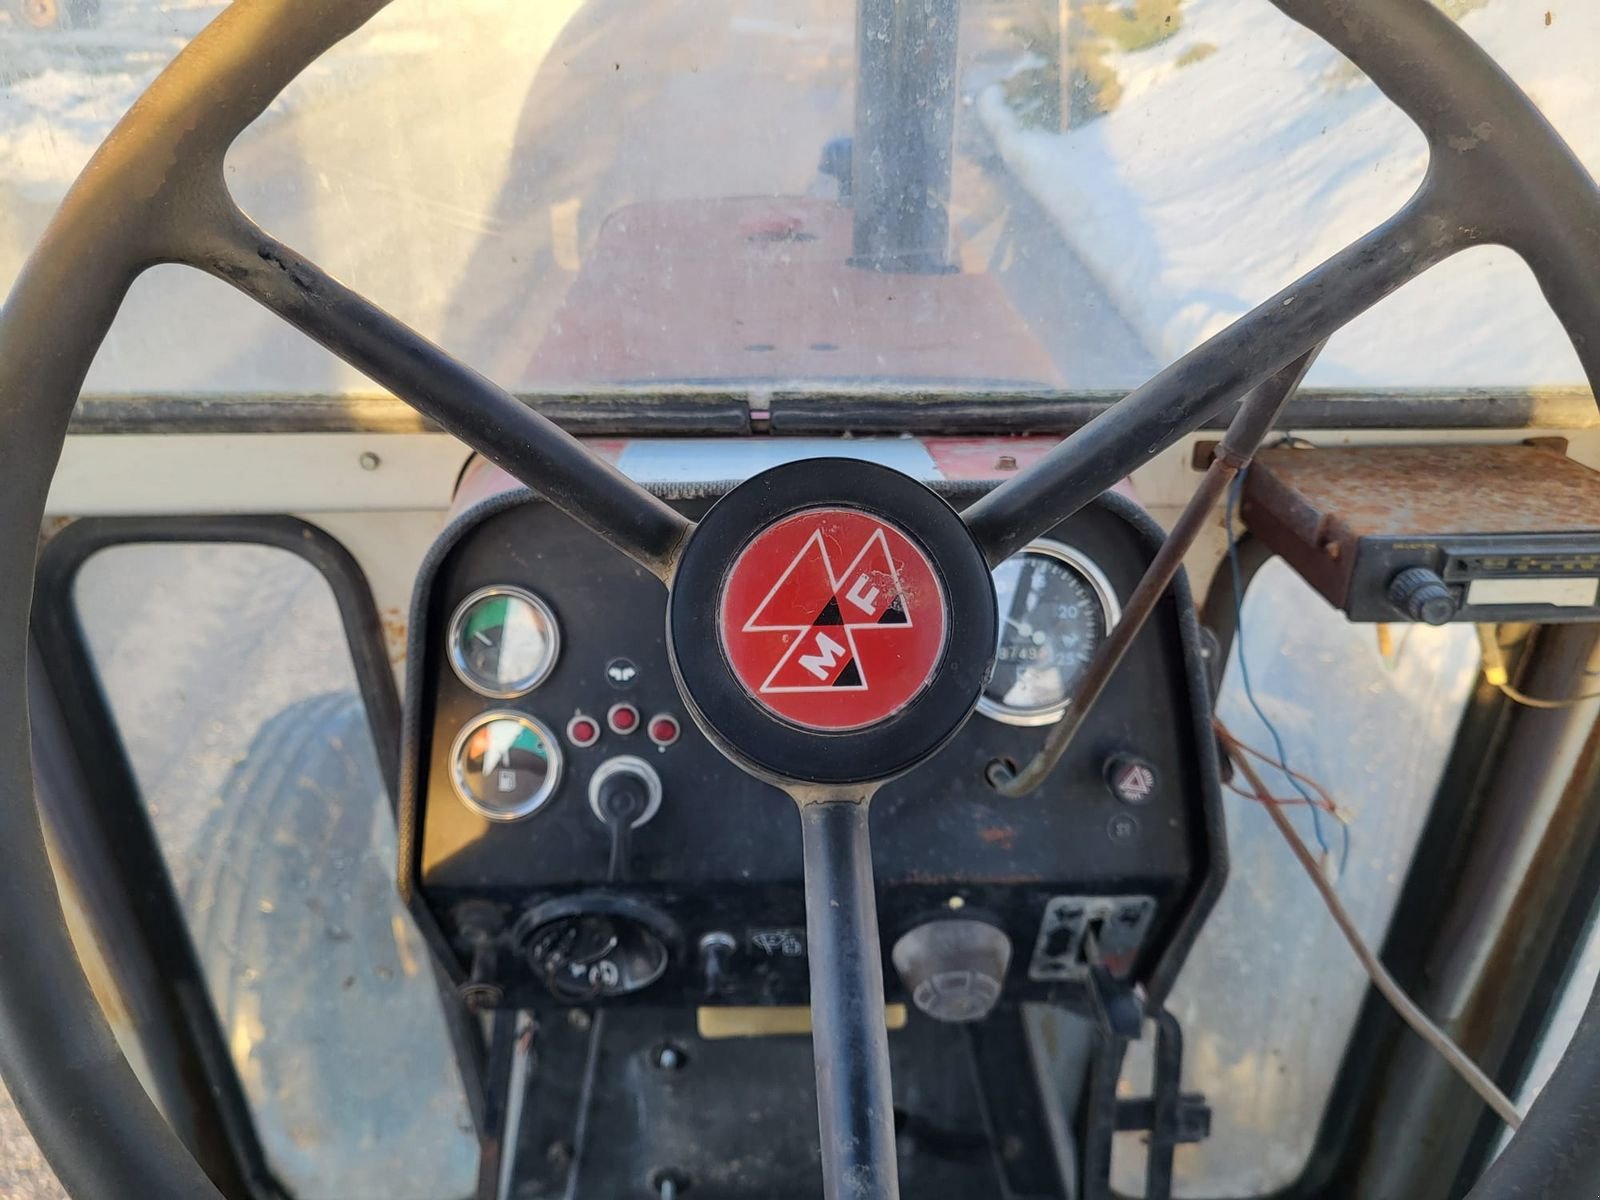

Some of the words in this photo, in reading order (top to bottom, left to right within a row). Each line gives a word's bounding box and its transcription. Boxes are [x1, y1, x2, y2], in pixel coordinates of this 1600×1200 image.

[1057, 605, 1078, 619] 20
[798, 631, 846, 681] M
[845, 572, 880, 616] F
[1055, 652, 1076, 666] 25
